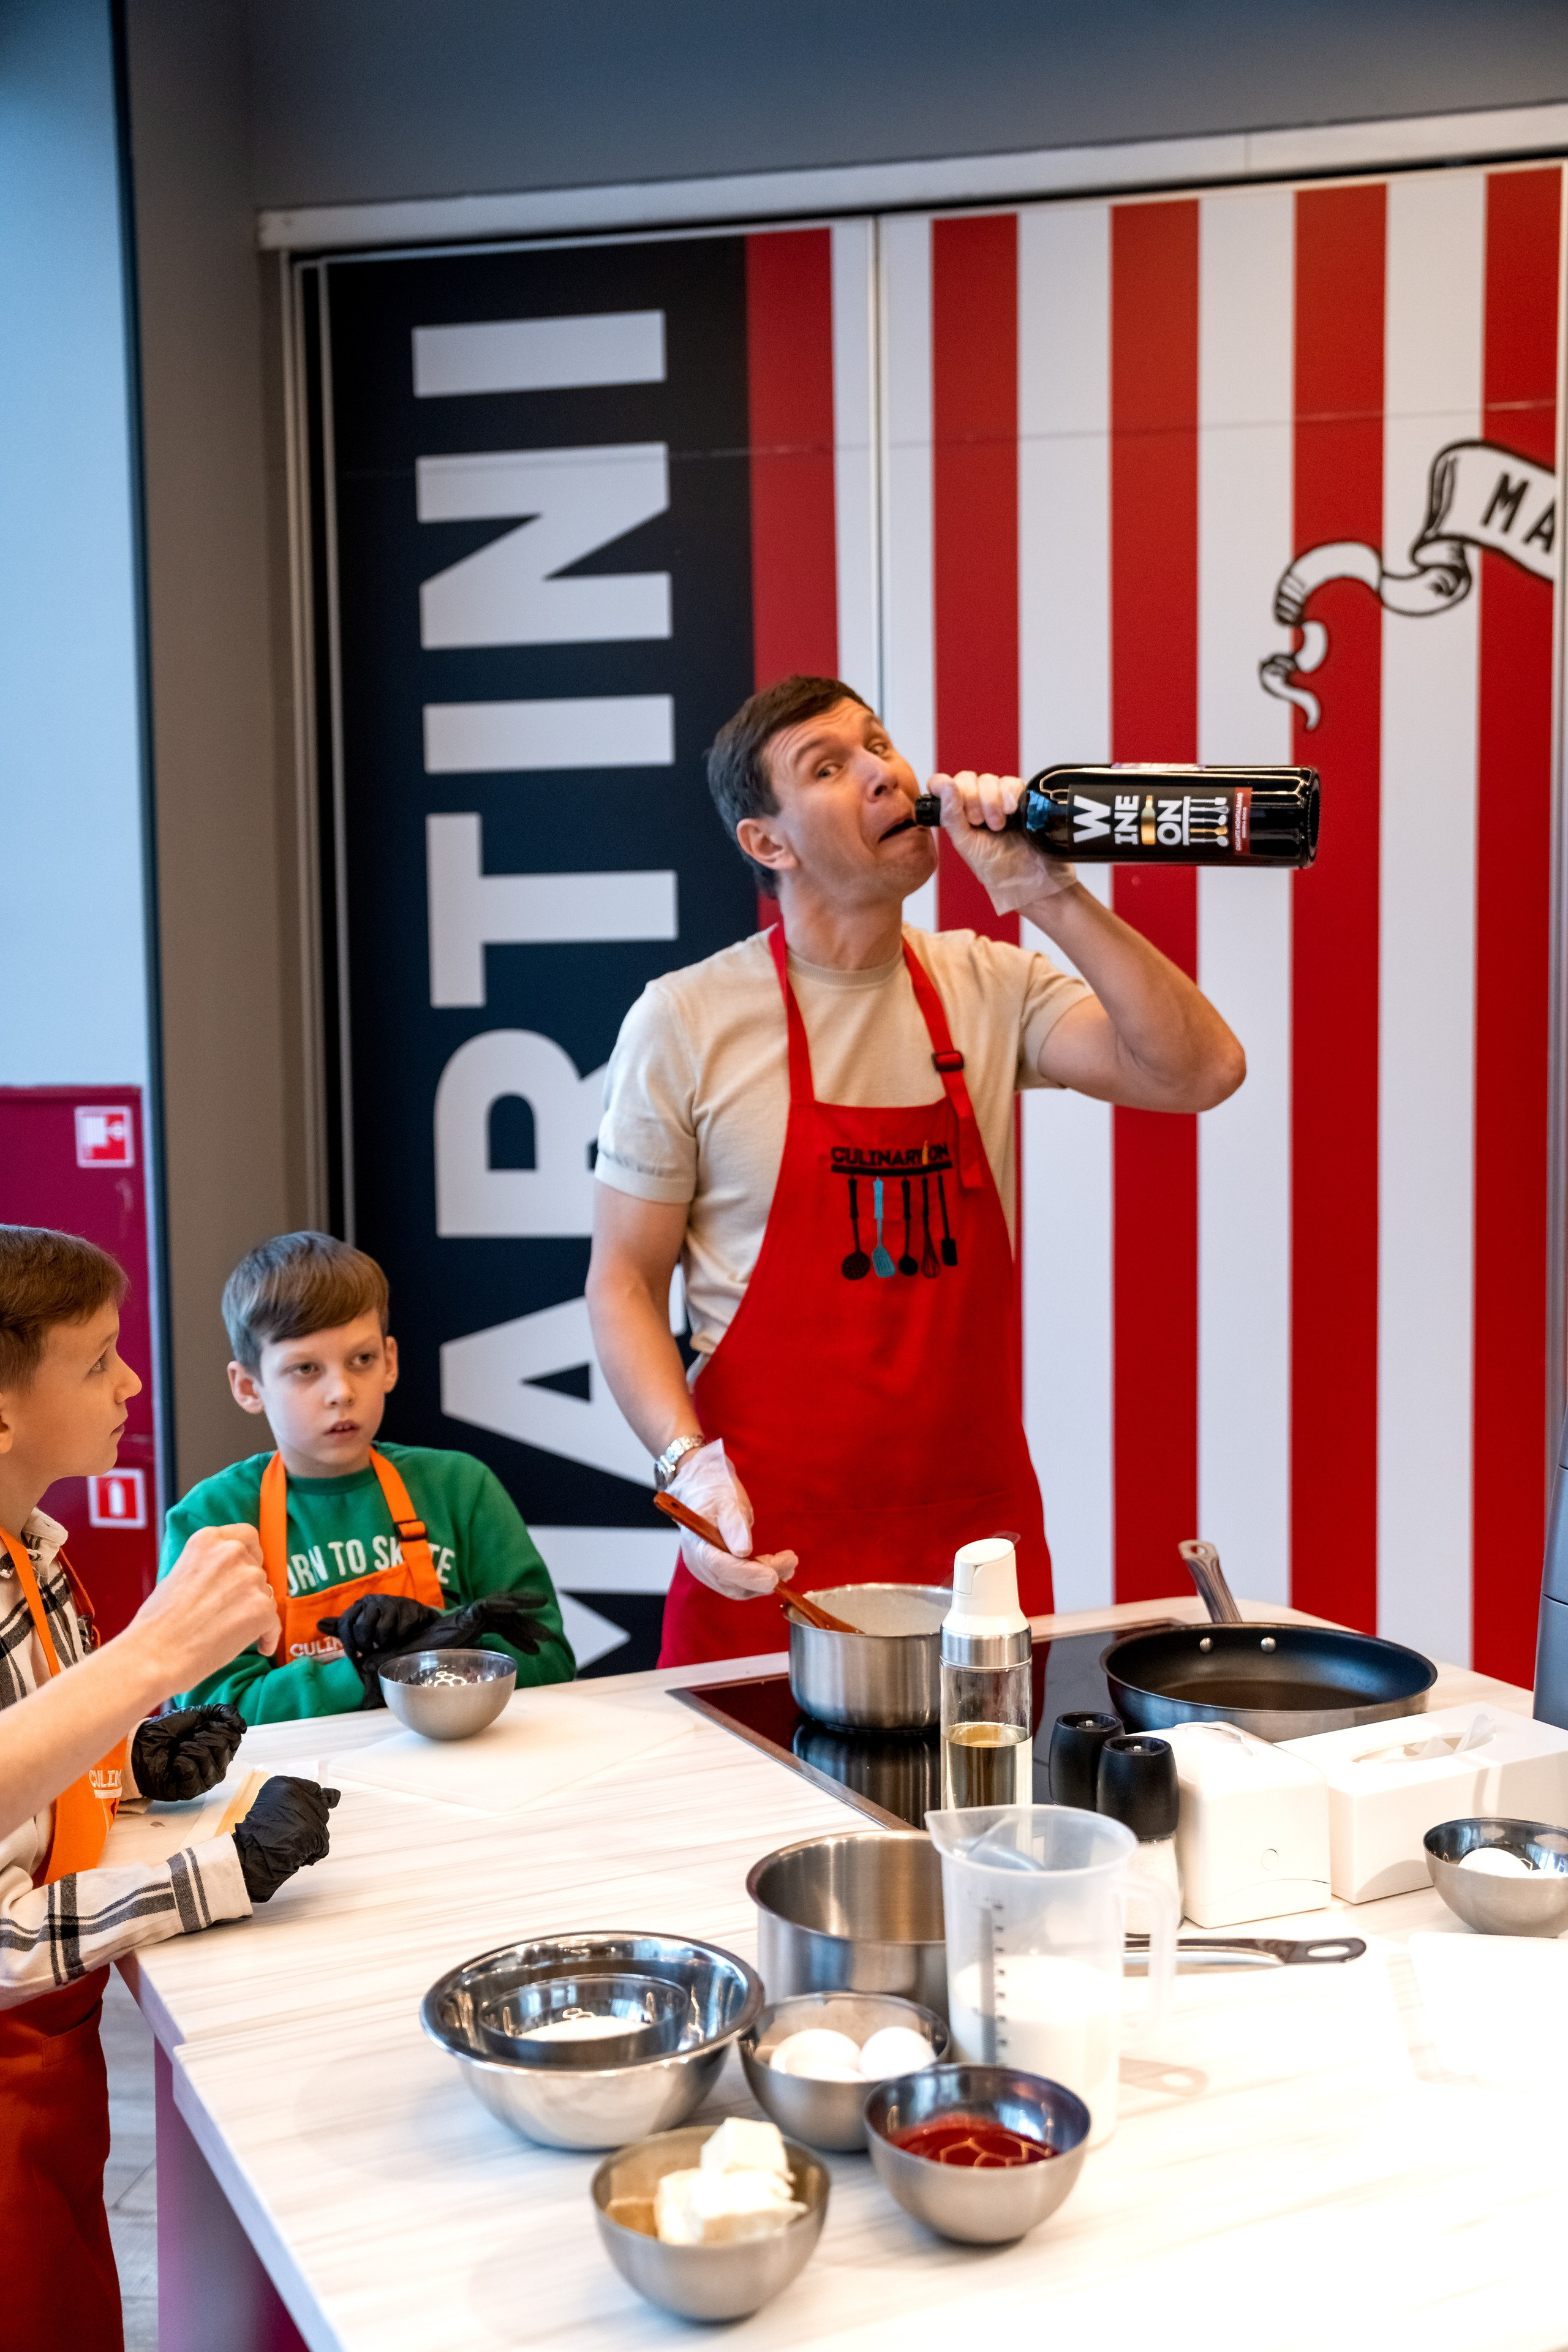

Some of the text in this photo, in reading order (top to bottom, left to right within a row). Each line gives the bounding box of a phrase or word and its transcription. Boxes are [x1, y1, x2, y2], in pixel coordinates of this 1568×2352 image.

[1114, 794, 1140, 845] INE
[1157, 799, 1183, 845] ON
[287, 1535, 456, 1597] RN TO SKE
